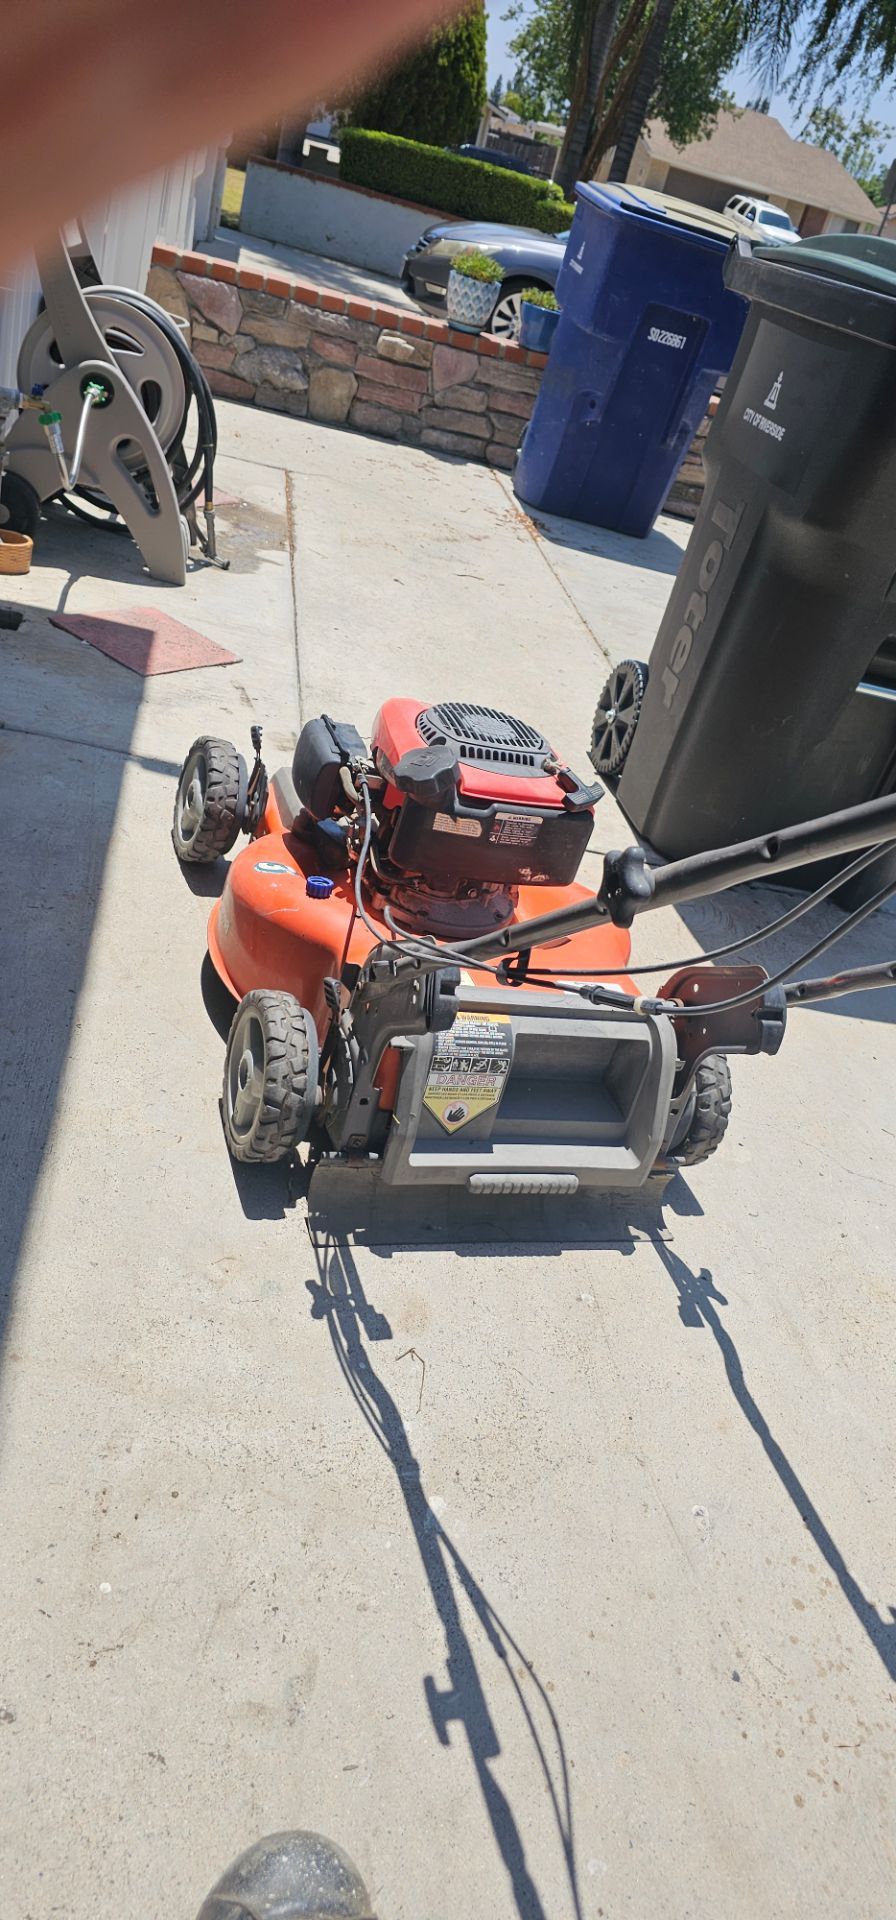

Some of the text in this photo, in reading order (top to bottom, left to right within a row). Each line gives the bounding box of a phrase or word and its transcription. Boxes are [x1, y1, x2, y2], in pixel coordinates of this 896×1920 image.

[743, 407, 786, 441] CITY OF RIVERSIDE
[661, 498, 747, 709] Toter
[436, 1074, 496, 1086] DANGER
